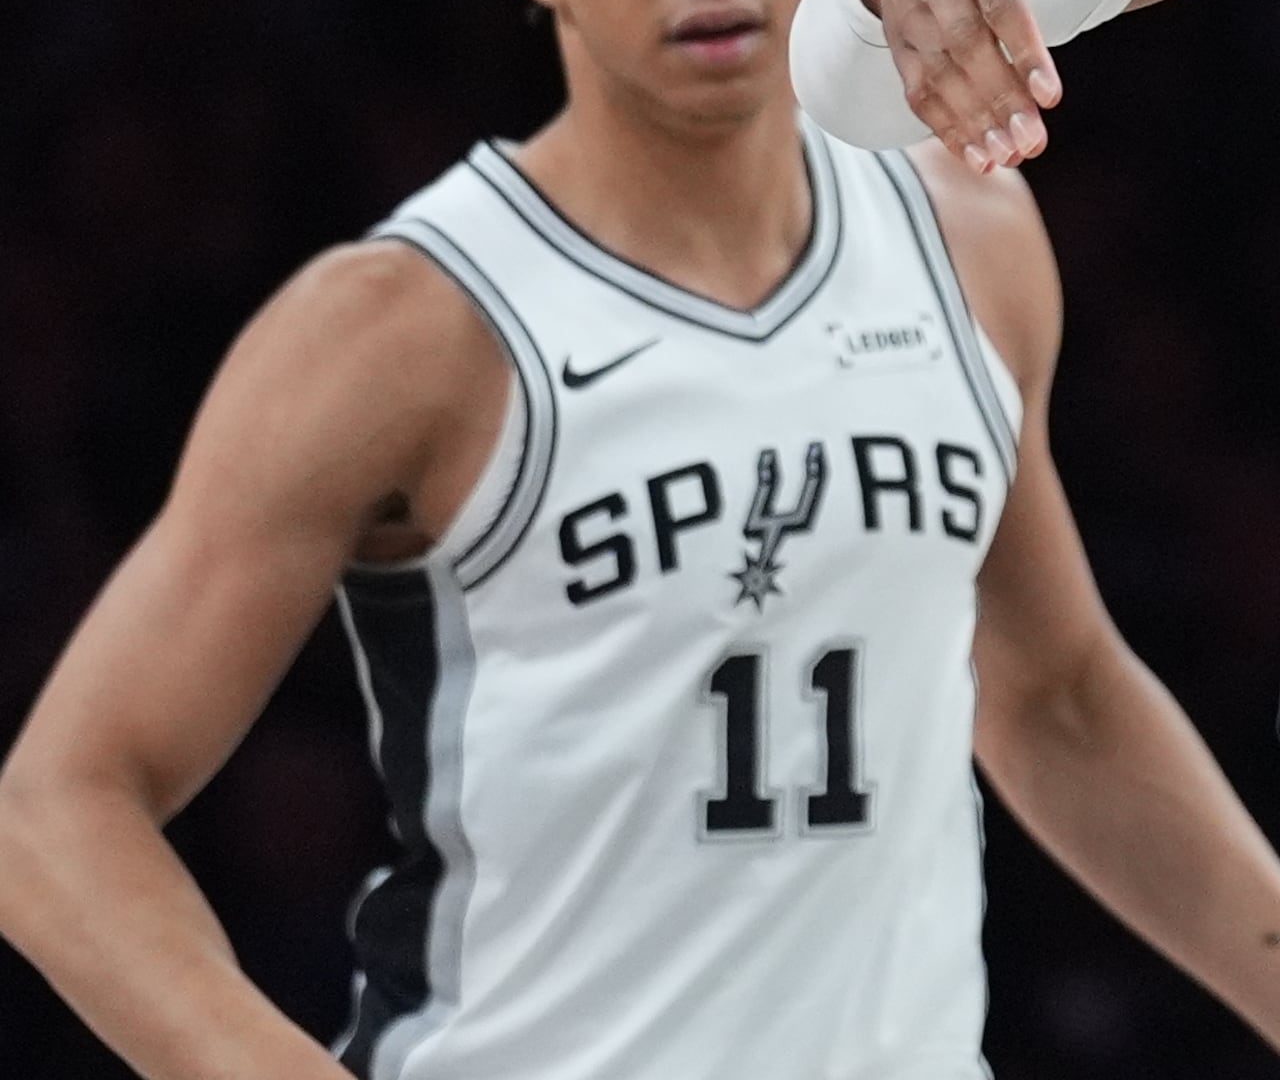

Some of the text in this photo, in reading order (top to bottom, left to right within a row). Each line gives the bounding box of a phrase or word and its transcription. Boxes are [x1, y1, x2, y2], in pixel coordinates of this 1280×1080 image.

[845, 326, 928, 355] LEDGER
[557, 435, 987, 612] SPURS
[697, 637, 877, 845] 11
